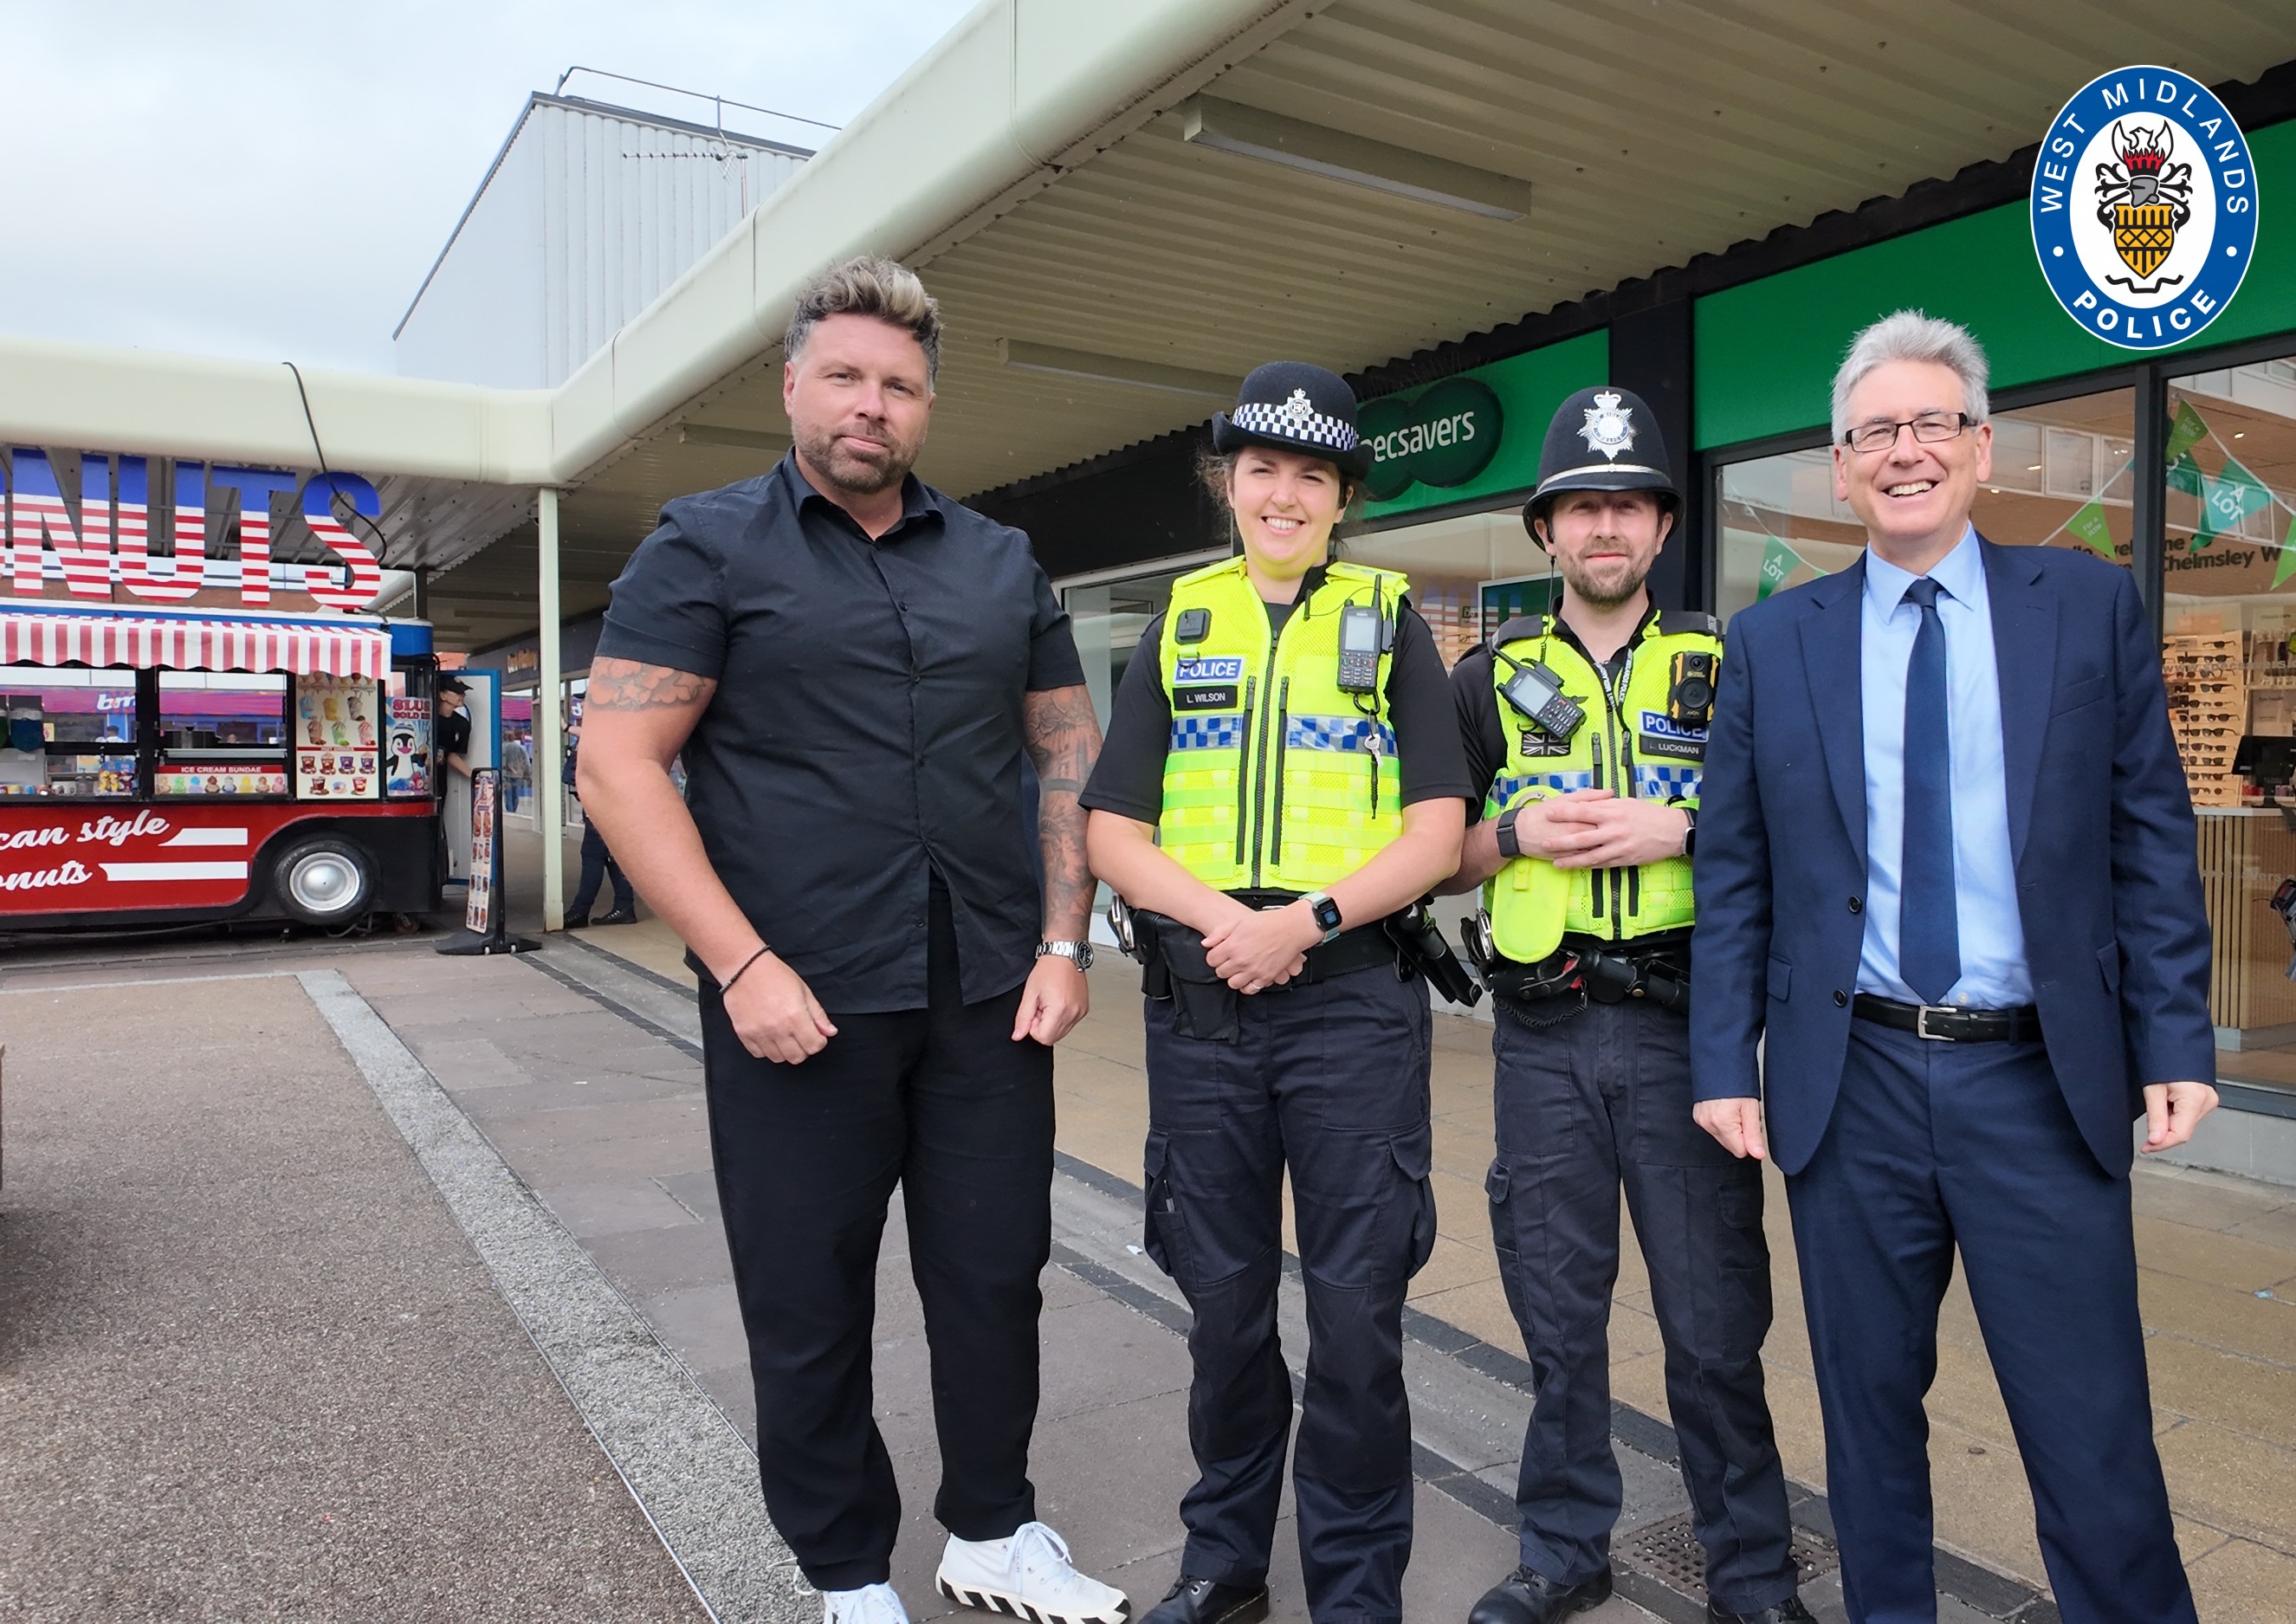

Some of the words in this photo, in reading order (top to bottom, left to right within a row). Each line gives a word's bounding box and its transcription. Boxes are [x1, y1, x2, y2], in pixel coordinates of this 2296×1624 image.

[1358, 411, 1475, 463] ecsavers
[2210, 489, 2245, 521] LOT
[2228, 485, 2245, 503] A
[0, 448, 382, 611] NUTS
[1762, 559, 1784, 581] LOT
[1773, 554, 1782, 566] A
[1179, 661, 1238, 677] POLICE
[1194, 692, 1226, 703] WILSON
[392, 710, 419, 720] SOLD
[1646, 715, 1705, 739] POLICE
[1658, 742, 1699, 754] LUCKMAN
[76, 809, 171, 846] style
[0, 860, 93, 891] nuts
